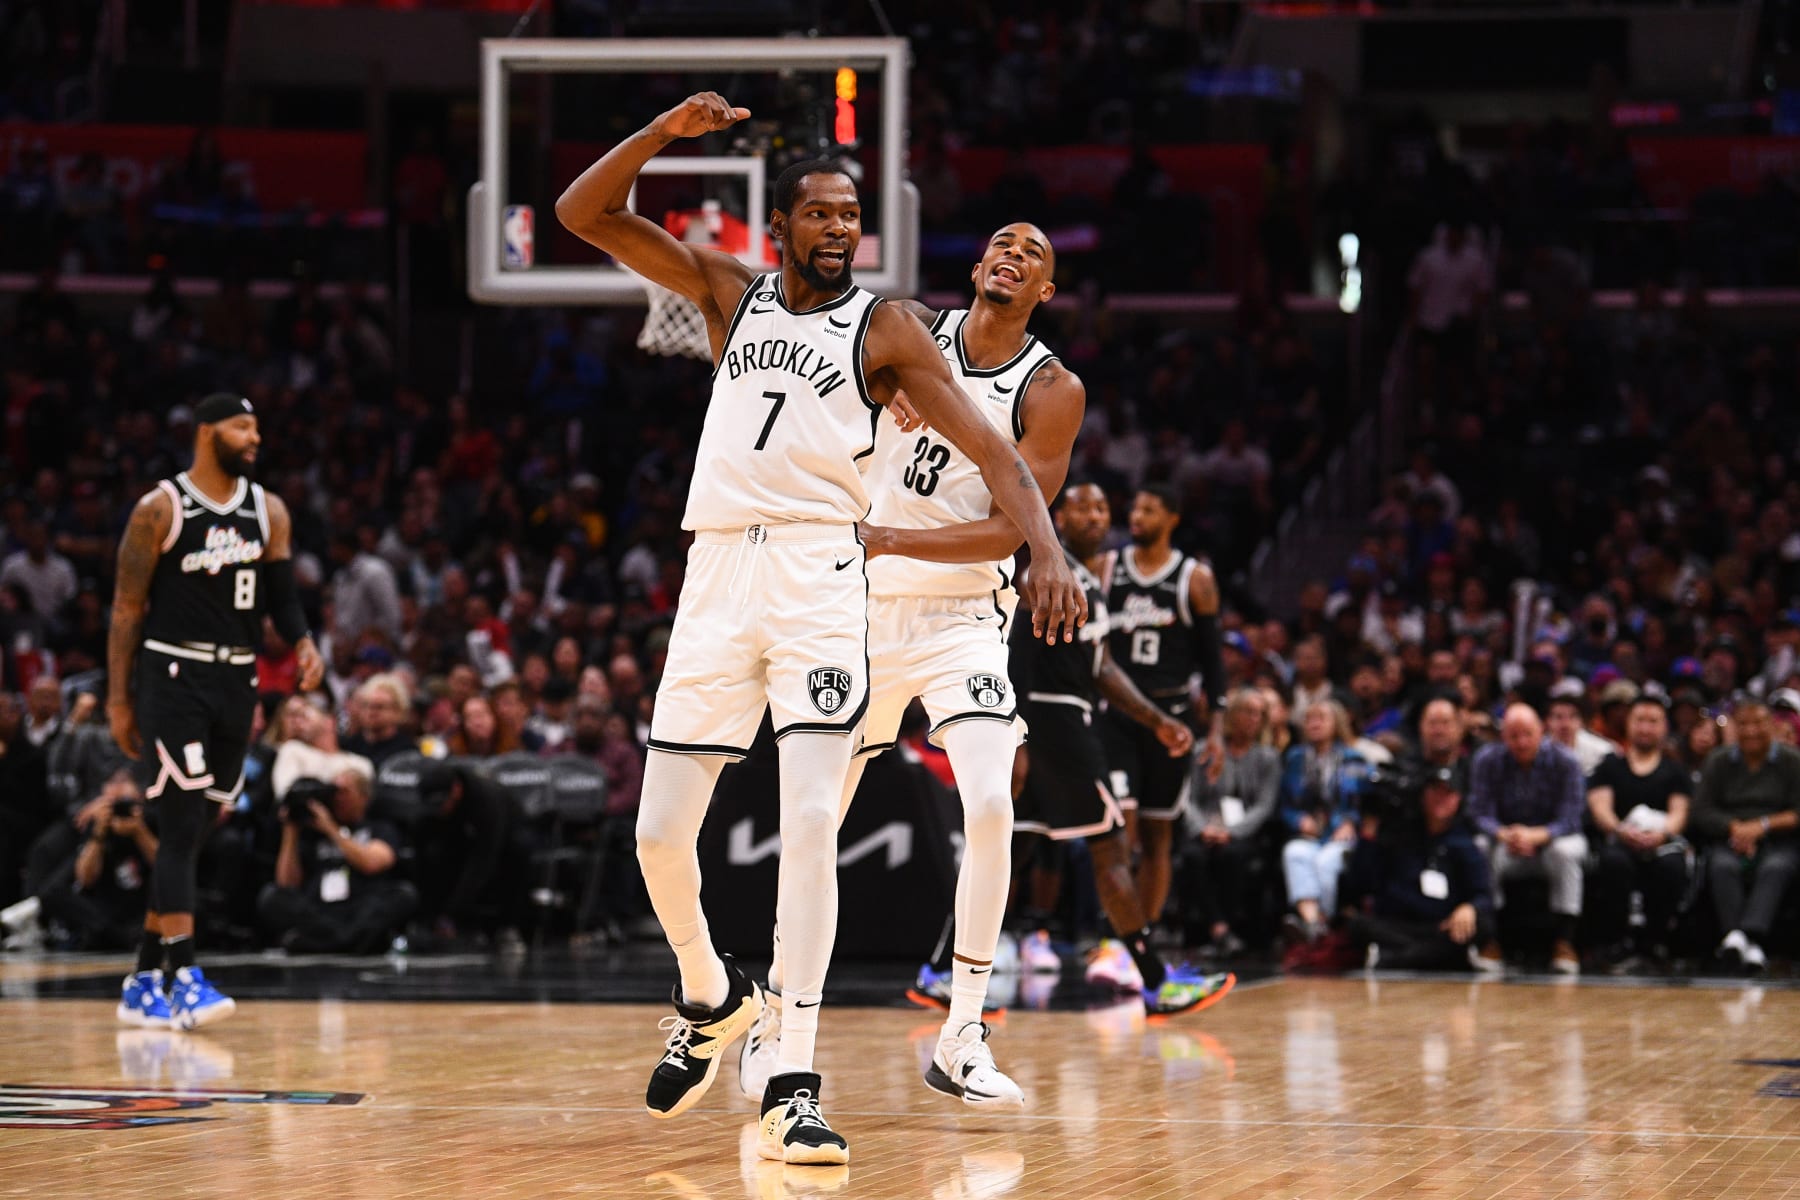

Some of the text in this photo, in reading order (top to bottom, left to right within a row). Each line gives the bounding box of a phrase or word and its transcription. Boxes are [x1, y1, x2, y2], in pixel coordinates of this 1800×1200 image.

[758, 292, 773, 301] 6
[823, 327, 847, 340] Webull
[937, 336, 949, 350] 6
[727, 340, 847, 399] BROOKLYN
[753, 391, 786, 451] 7
[903, 436, 950, 497] 33
[233, 568, 257, 611] 8
[810, 670, 849, 691] NETS
[970, 675, 1005, 695] NETS
[825, 691, 833, 708] B
[985, 691, 993, 704] B
